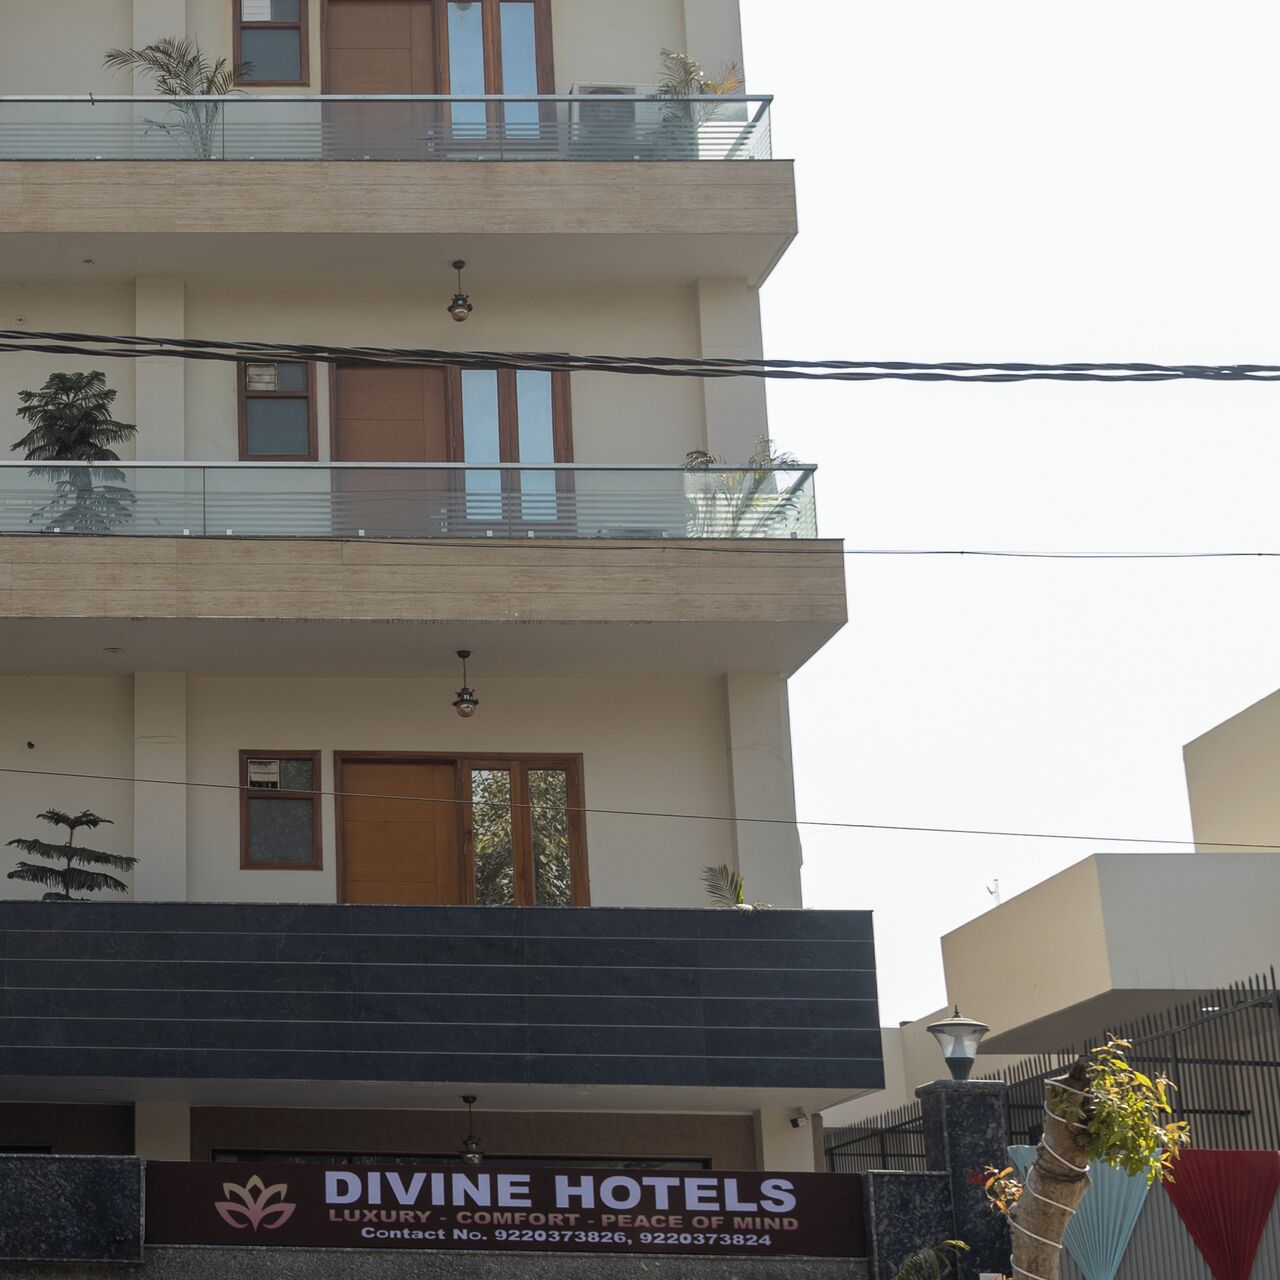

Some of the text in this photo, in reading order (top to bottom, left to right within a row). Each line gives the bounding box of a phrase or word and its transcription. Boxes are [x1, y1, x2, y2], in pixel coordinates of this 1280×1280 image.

[324, 1171, 797, 1213] DIVINE HOTELS
[328, 1208, 432, 1224] LUXURY
[456, 1211, 581, 1227] COMFORT
[600, 1214, 684, 1228] PEACE
[691, 1215, 724, 1229] OF
[733, 1216, 799, 1231] MIND
[361, 1227, 772, 1246] Contact No. 9220373826, 9220373824
